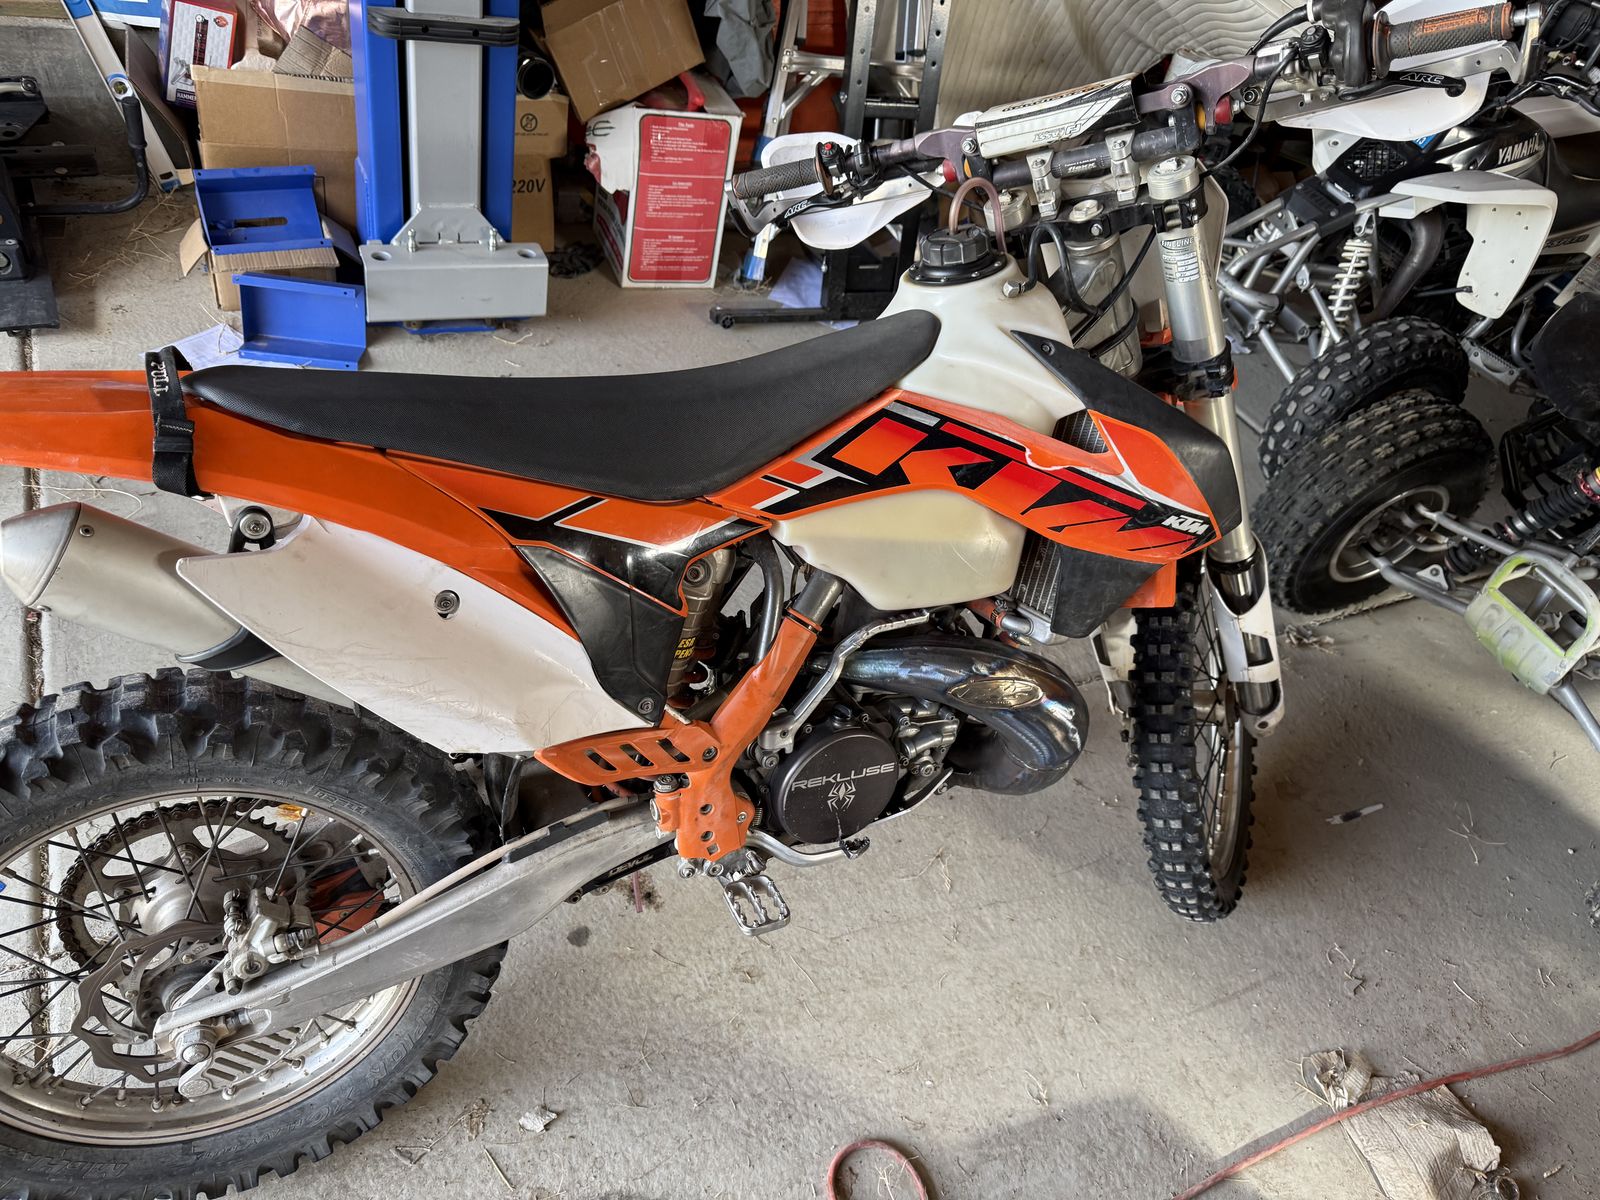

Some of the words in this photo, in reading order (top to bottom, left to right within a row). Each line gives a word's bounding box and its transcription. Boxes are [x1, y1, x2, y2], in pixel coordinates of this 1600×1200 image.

[1400, 72, 1445, 85] ARC
[1498, 133, 1543, 165] YAMAHA
[783, 199, 808, 219] ARC
[1161, 514, 1210, 535] KTM
[791, 762, 896, 791] REKLUSE
